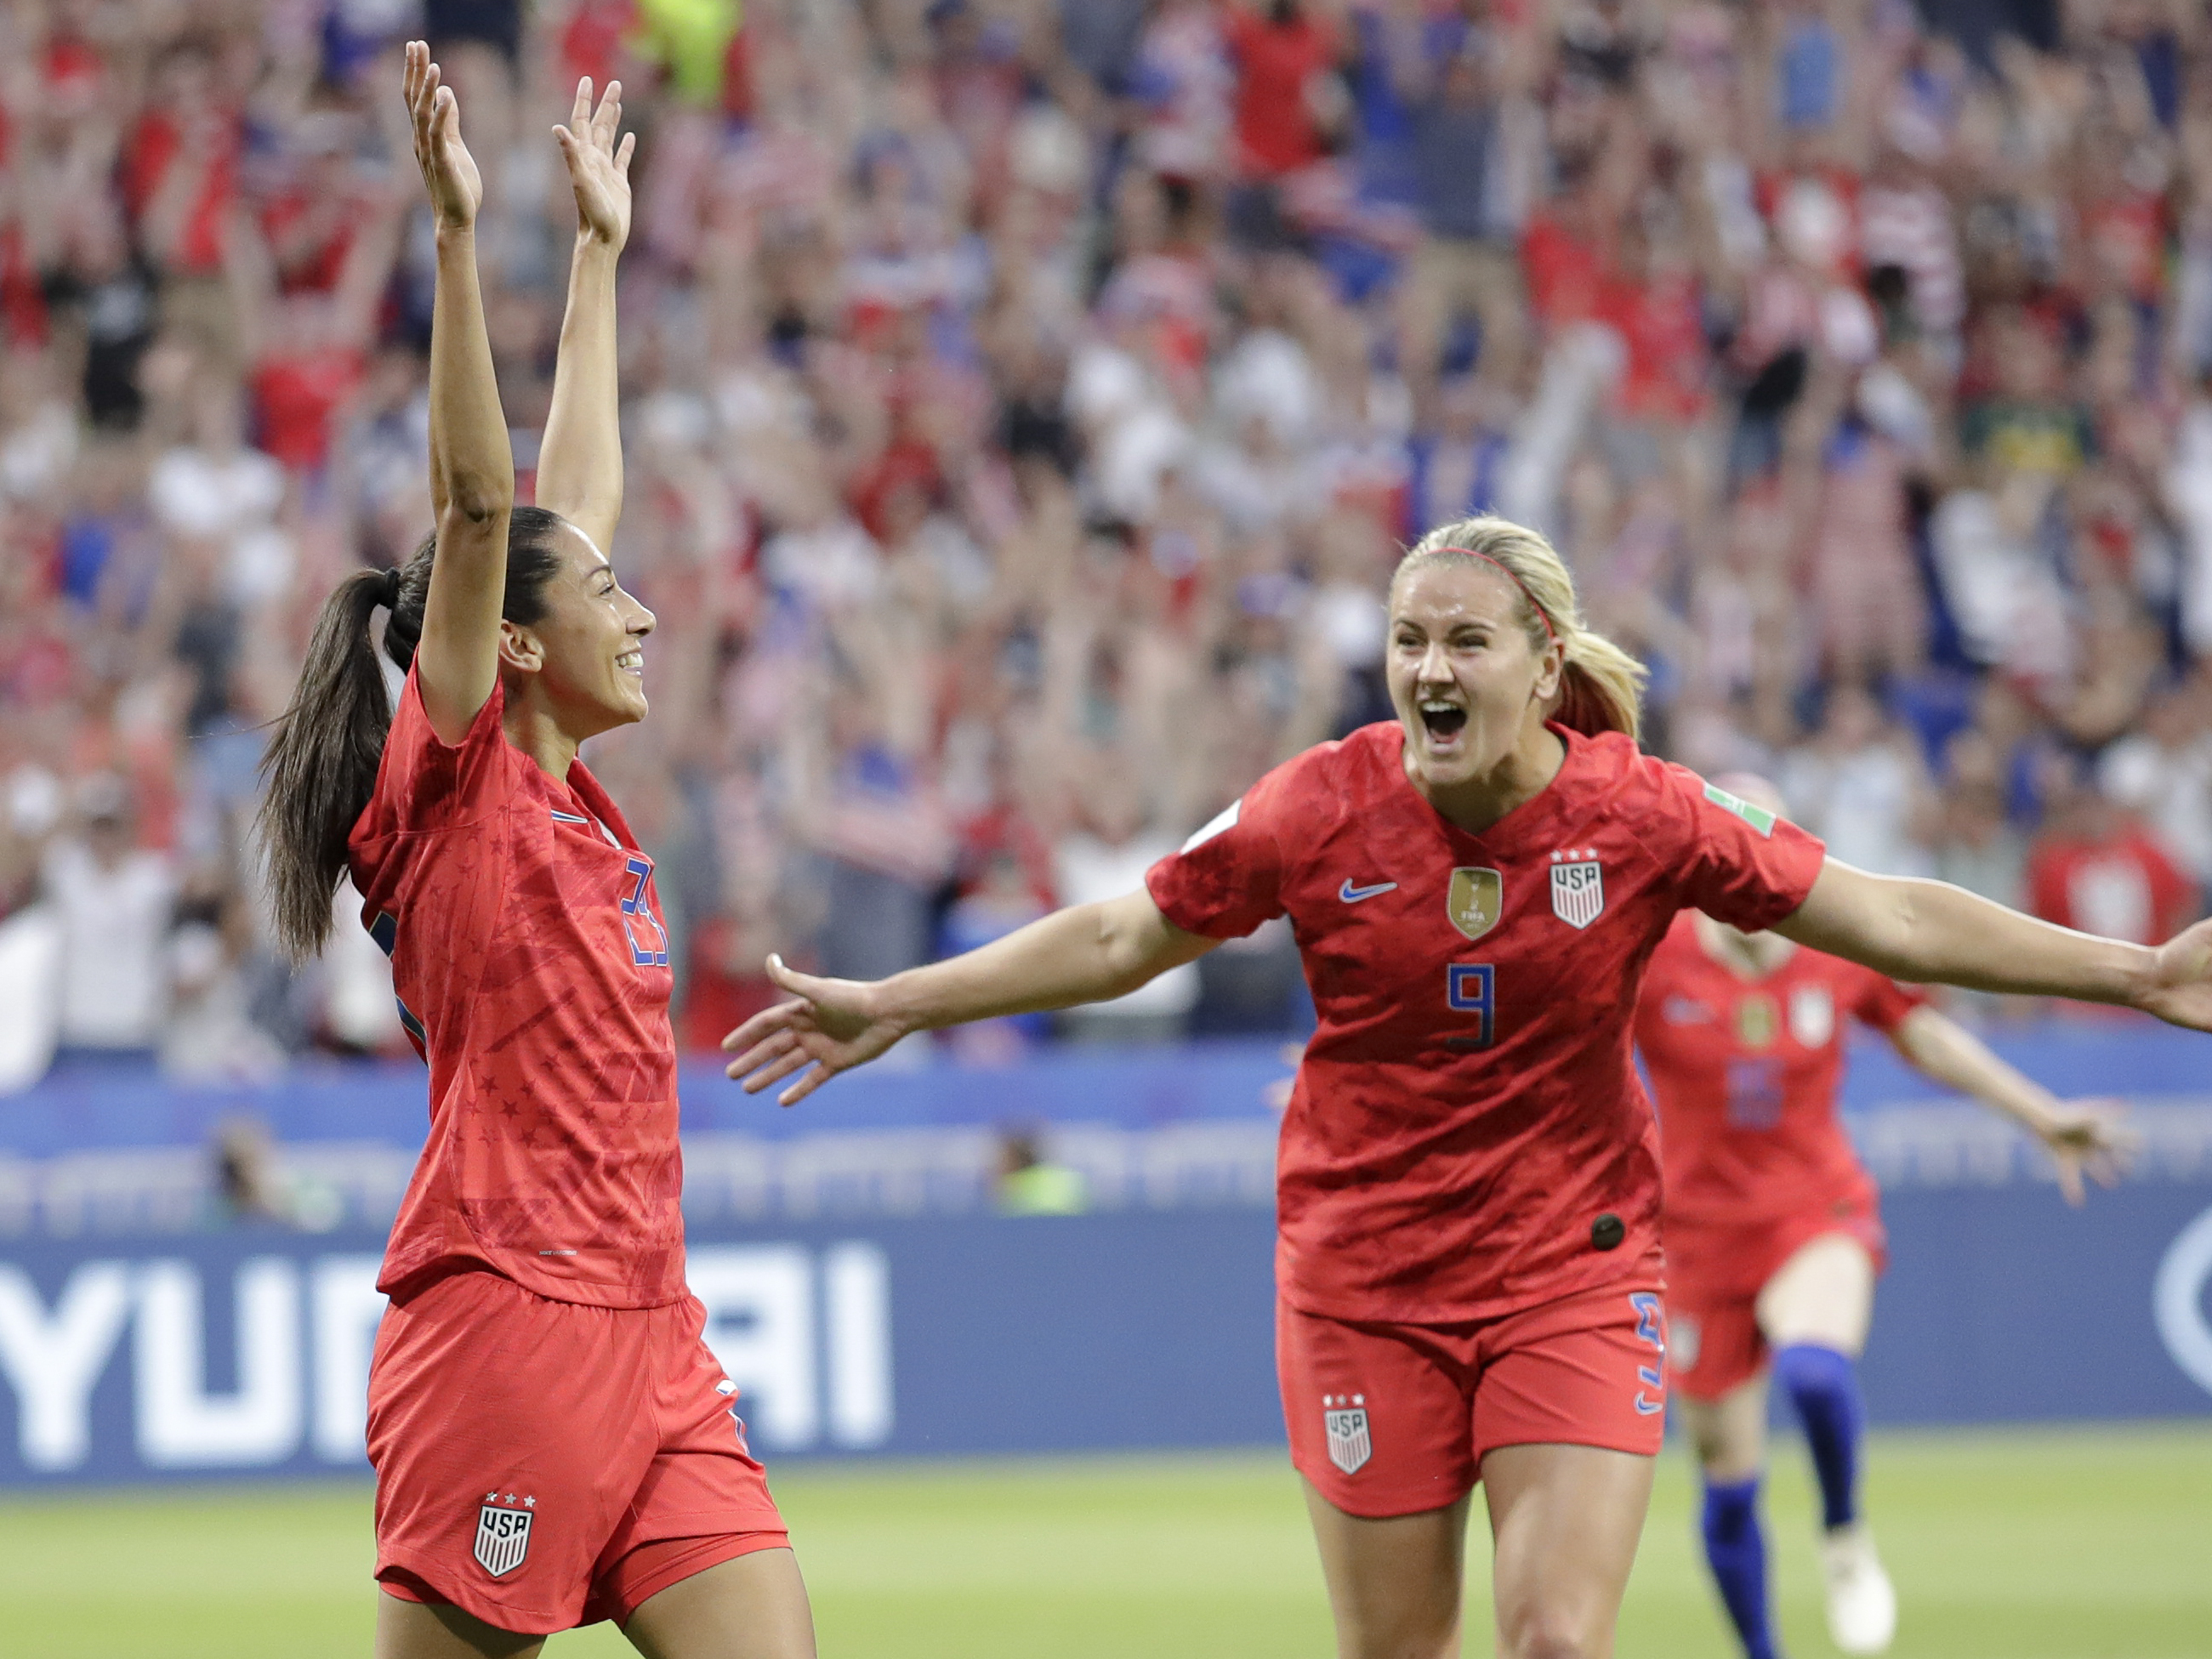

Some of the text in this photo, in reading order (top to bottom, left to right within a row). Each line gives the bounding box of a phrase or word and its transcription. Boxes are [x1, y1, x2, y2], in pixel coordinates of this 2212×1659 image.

[1555, 867, 1596, 890] USA
[1447, 963, 1494, 1047] 9
[0, 1243, 895, 1471] YUAI
[1329, 1414, 1362, 1437] USA
[483, 1510, 528, 1538] USA
